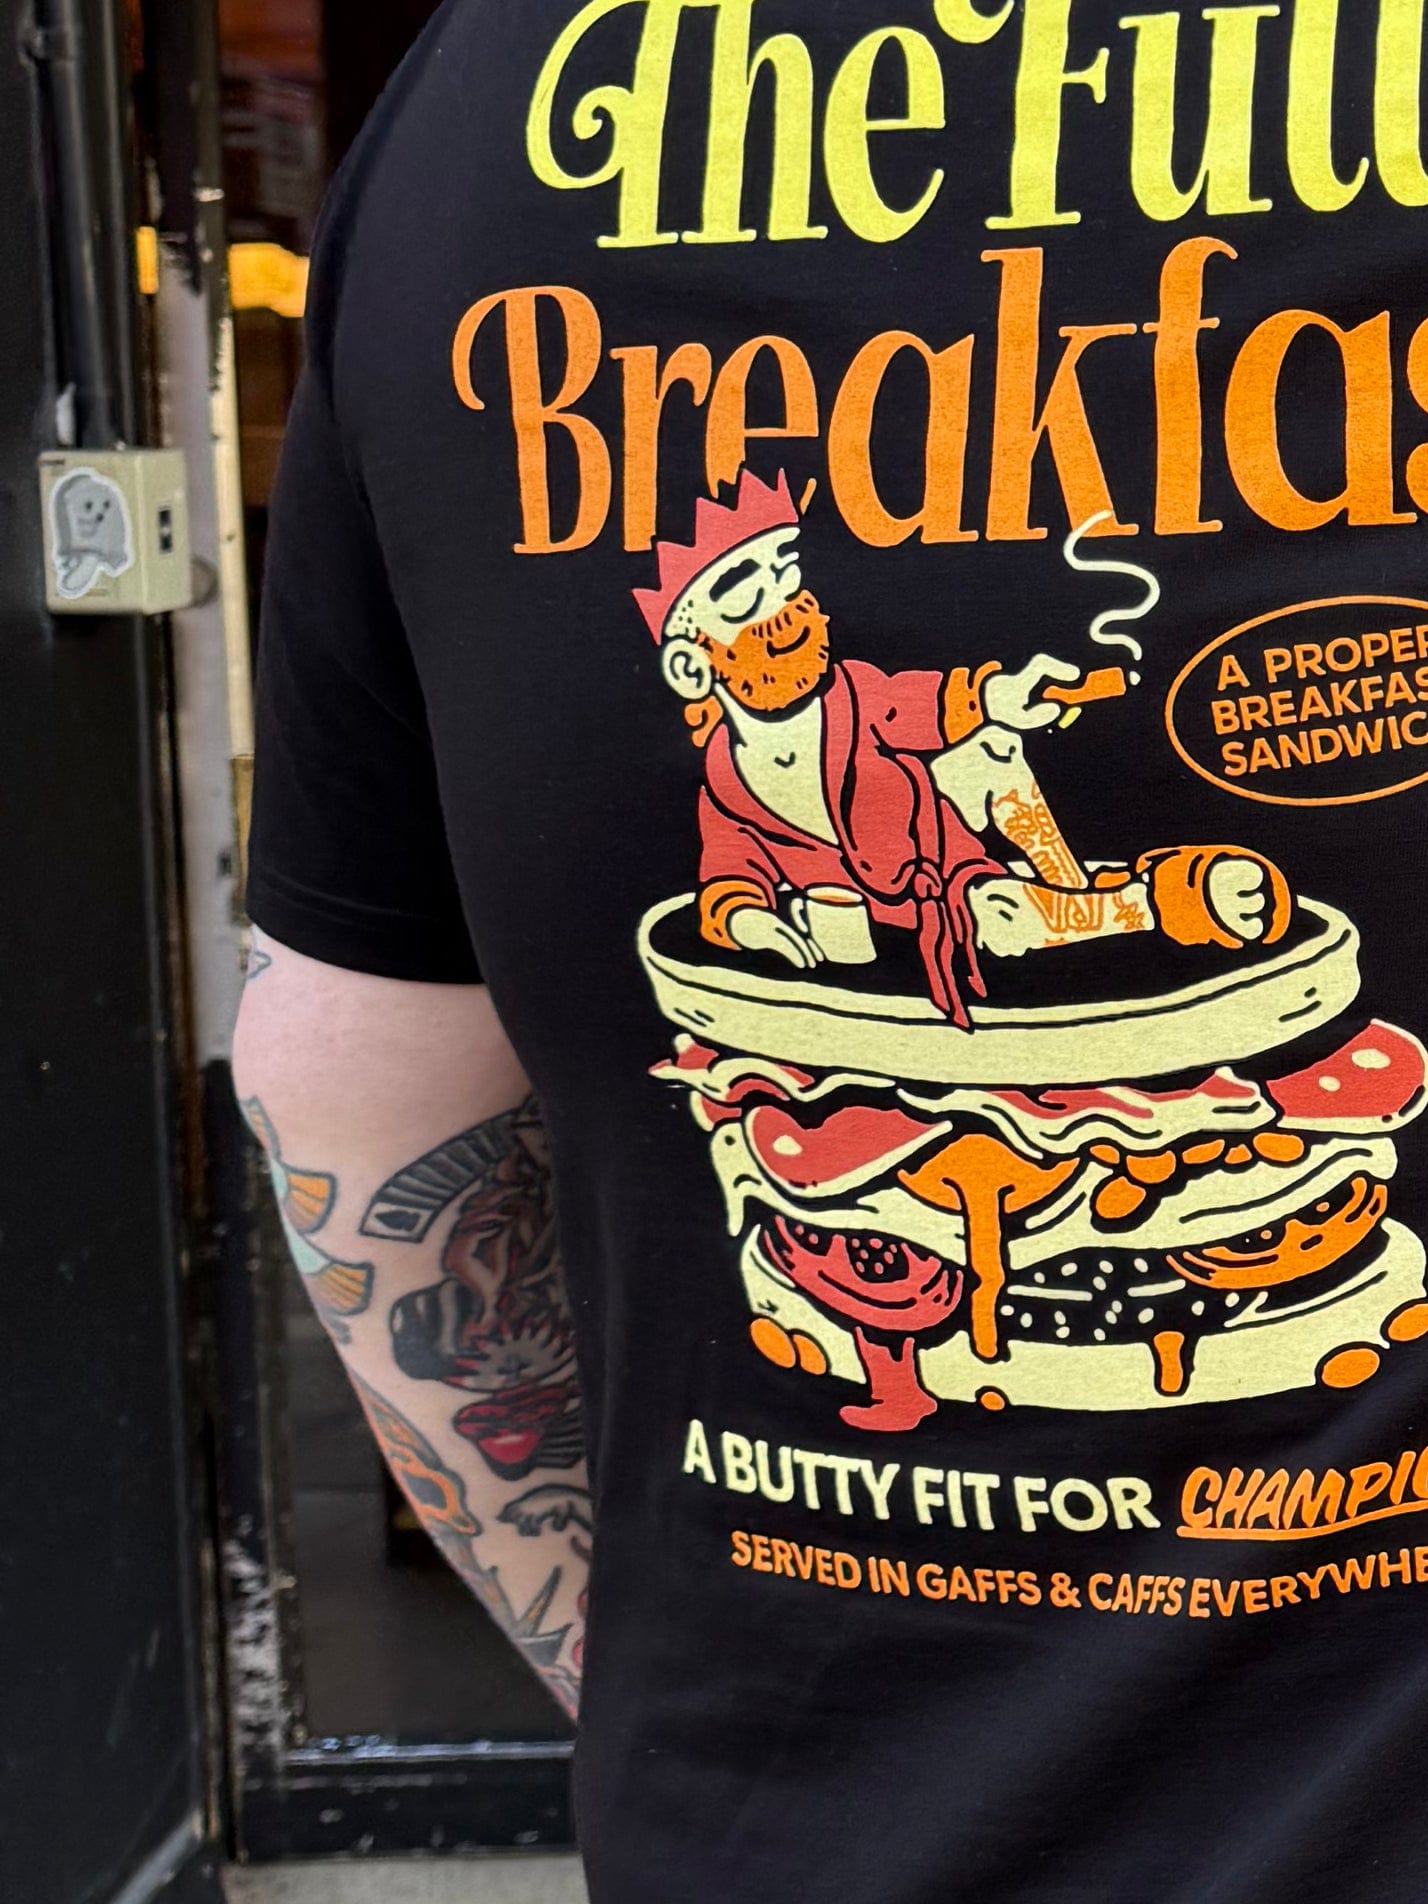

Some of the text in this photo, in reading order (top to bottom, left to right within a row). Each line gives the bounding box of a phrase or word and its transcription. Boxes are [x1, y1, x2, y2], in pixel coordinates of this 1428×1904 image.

[1217, 654, 1249, 691] A
[683, 1419, 716, 1484] A
[721, 1431, 901, 1520] BUTTY
[912, 1466, 1001, 1531] FIT
[1013, 1475, 1161, 1533] FOR
[731, 1530, 862, 1589] SERVED
[867, 1556, 910, 1597] IN
[916, 1563, 1042, 1606] GAFFS
[1049, 1572, 1082, 1608] &
[1088, 1572, 1186, 1617] CAFFS
